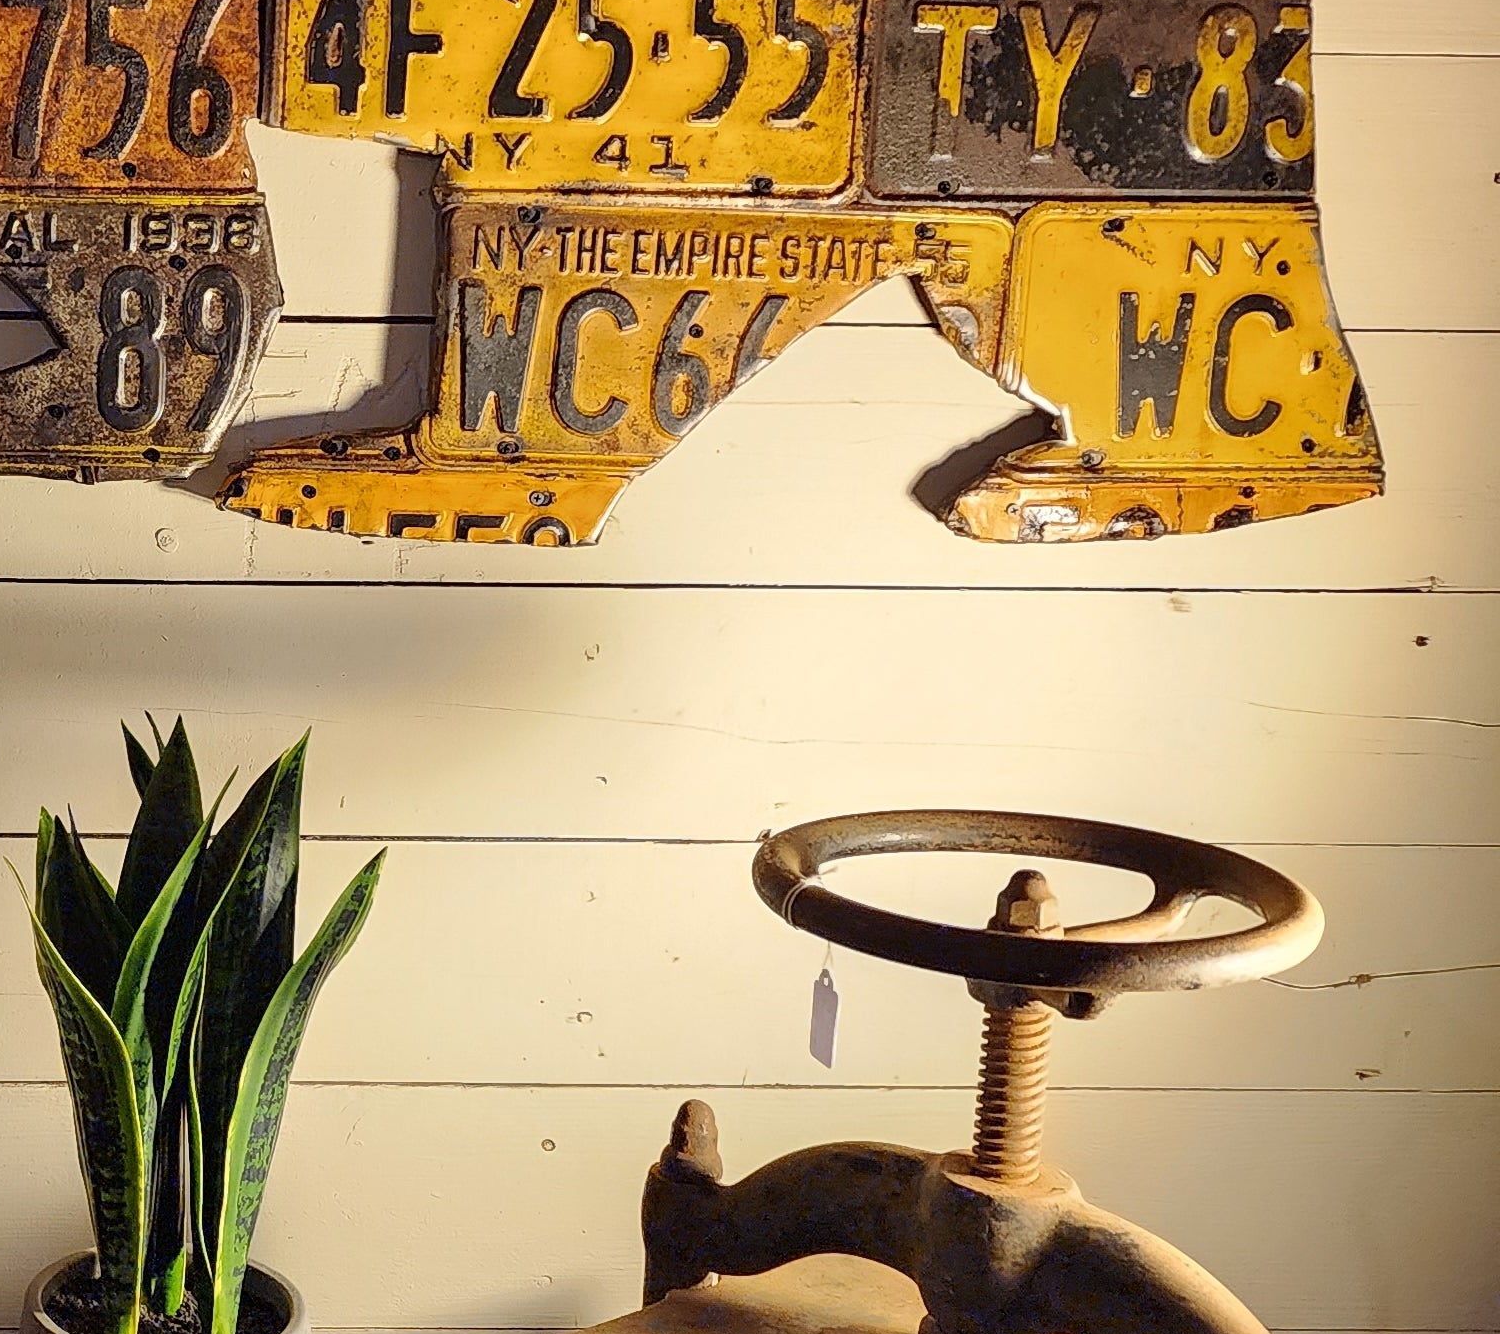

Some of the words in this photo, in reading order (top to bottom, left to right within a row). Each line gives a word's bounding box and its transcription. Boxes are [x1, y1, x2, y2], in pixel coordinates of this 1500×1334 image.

[591, 134, 691, 181] 41
[631, 232, 768, 281] EMPIRE
[780, 234, 886, 285] STATE
[1184, 237, 1282, 279] NY
